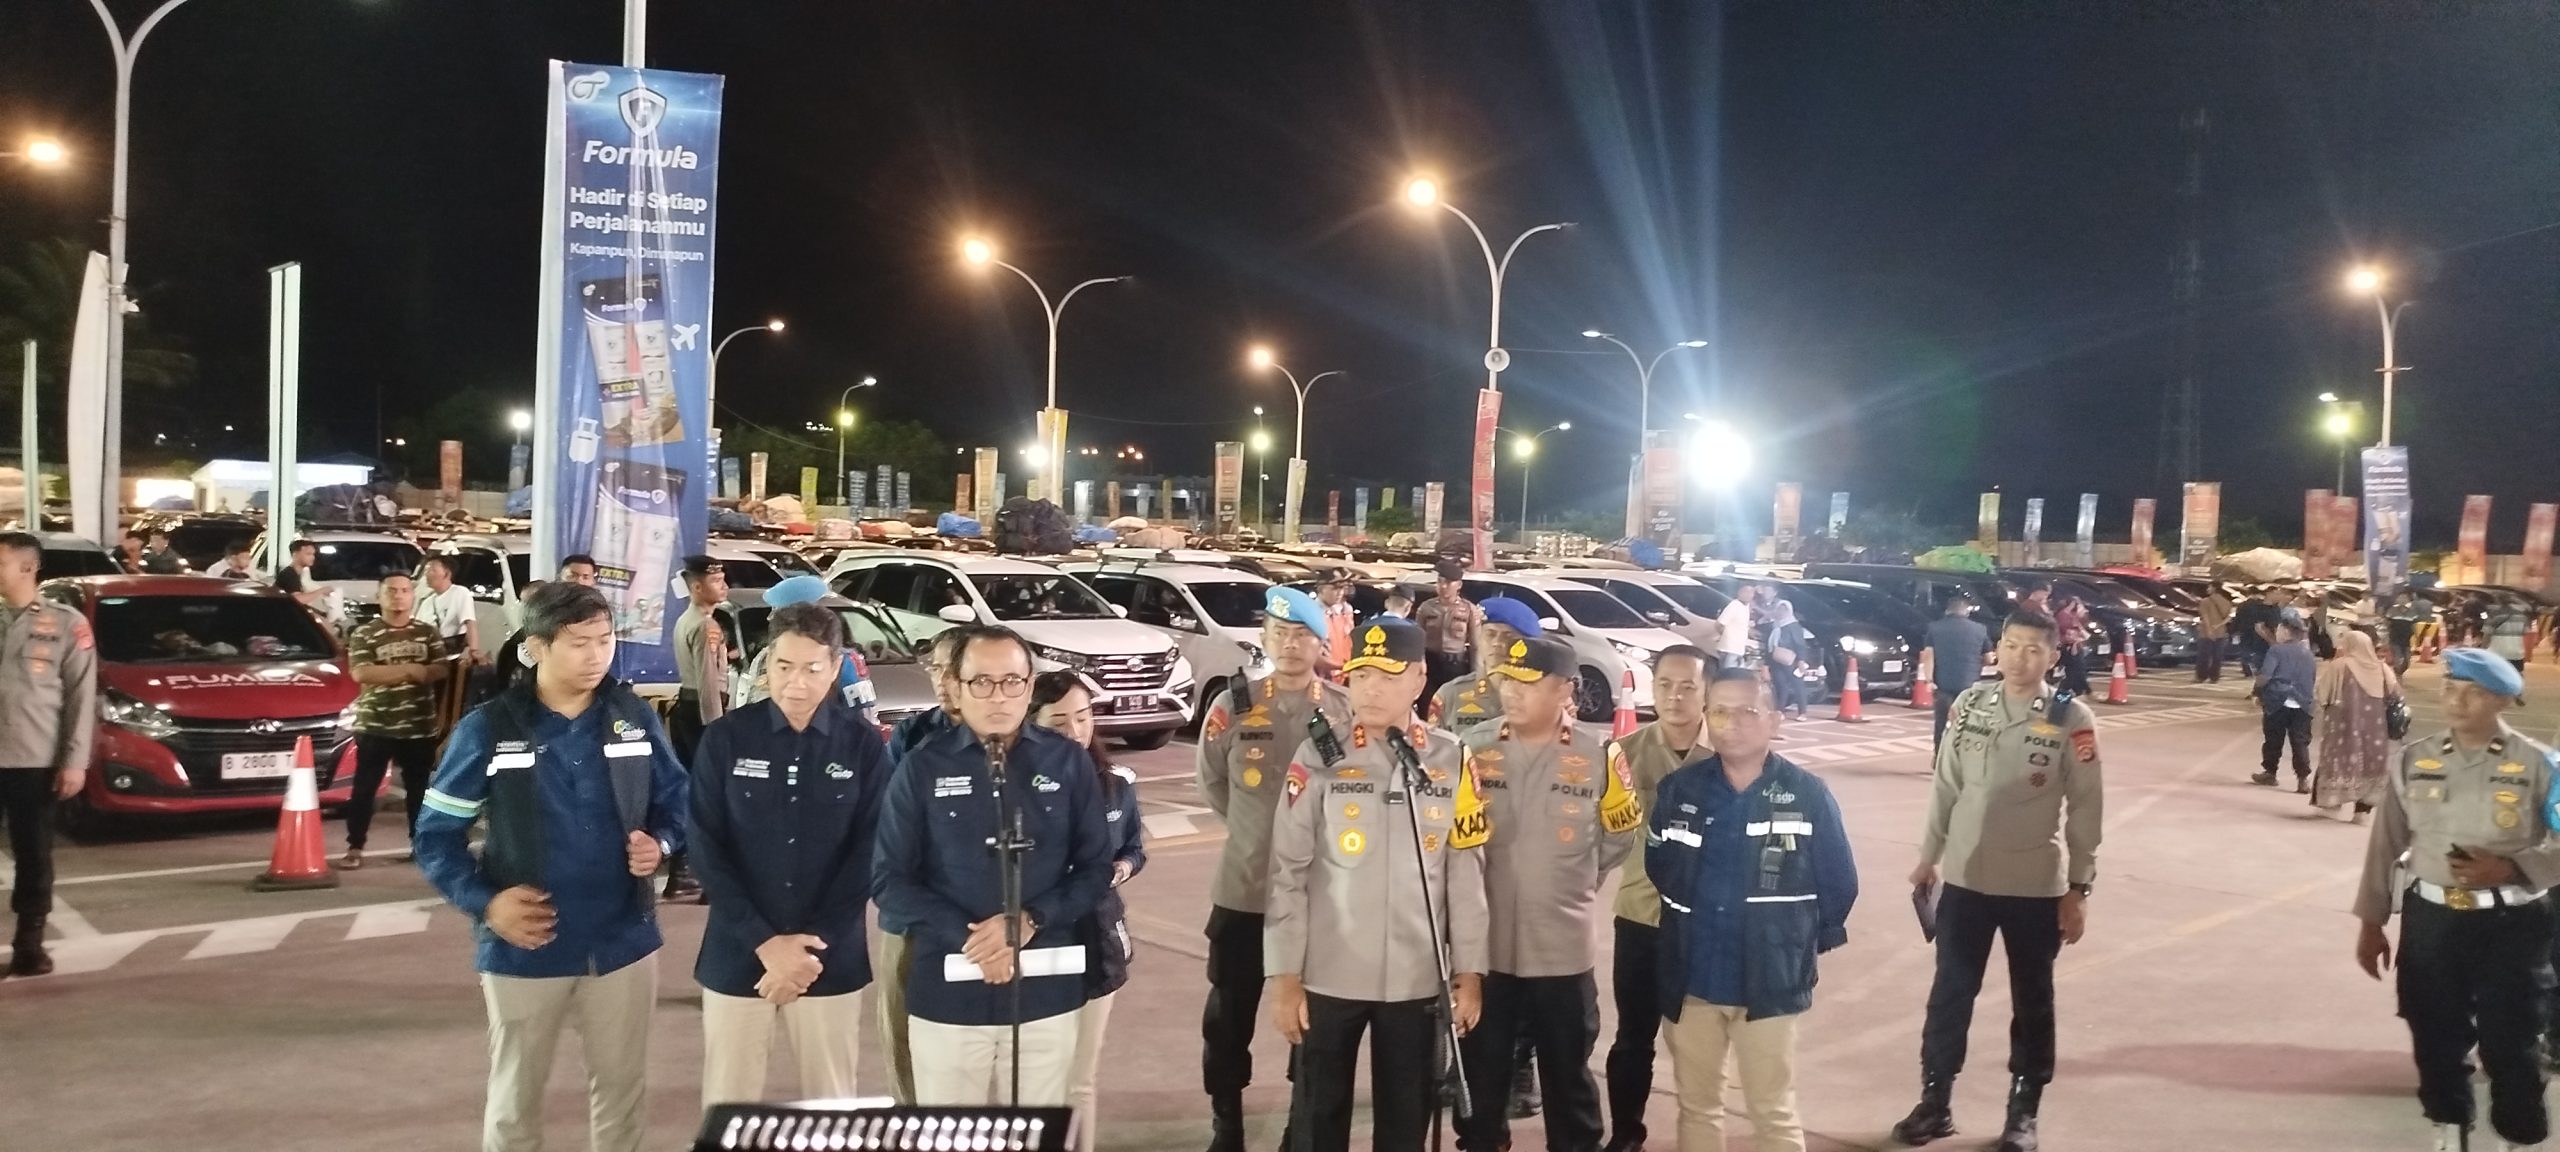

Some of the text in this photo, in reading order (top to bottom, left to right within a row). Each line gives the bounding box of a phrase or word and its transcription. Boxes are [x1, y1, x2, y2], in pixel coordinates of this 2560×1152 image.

[583, 140, 698, 170] Formula
[570, 187, 708, 214] Hadir di Setiap
[570, 211, 706, 235] Perjalananmu
[2024, 735, 2061, 750] POLRI
[1330, 782, 1375, 794] HENGKI
[1415, 785, 1452, 799] POLRI
[1480, 780, 1508, 790] NDRA
[1551, 784, 1593, 799] POLRI
